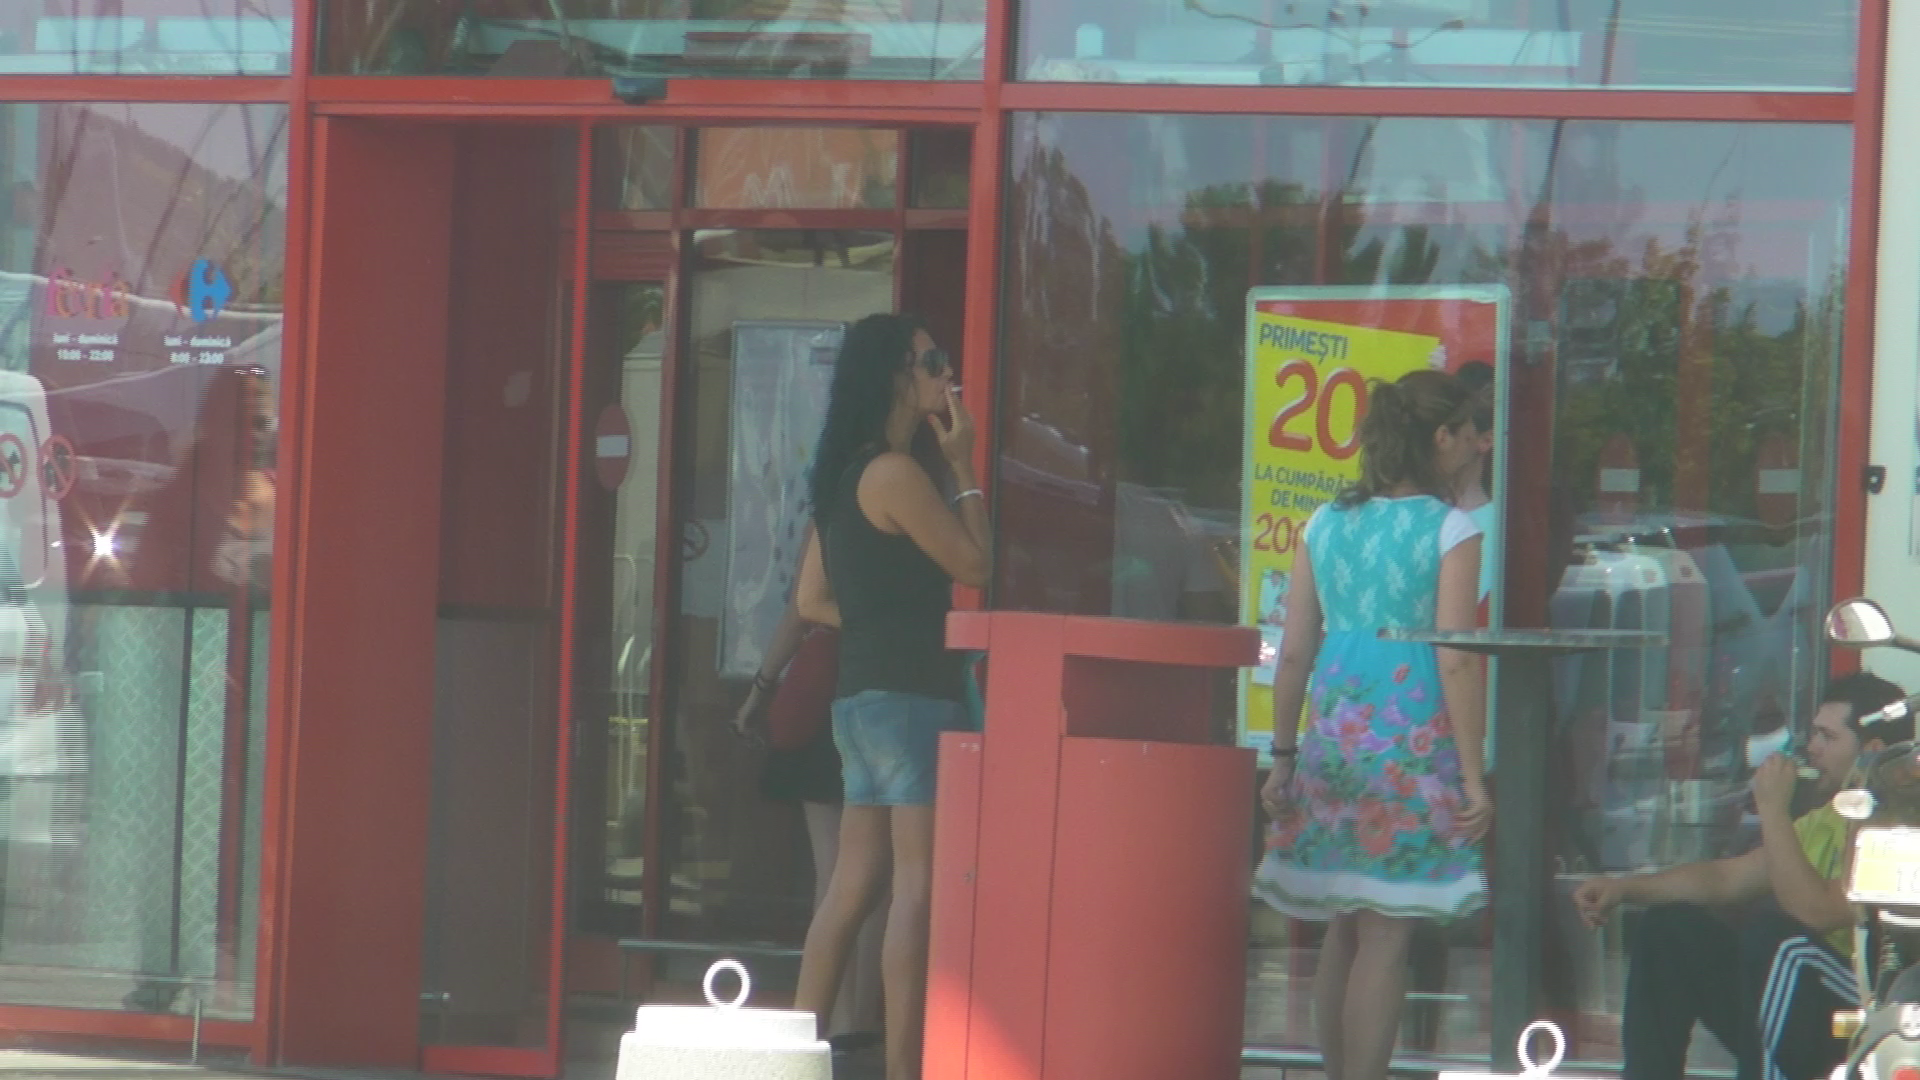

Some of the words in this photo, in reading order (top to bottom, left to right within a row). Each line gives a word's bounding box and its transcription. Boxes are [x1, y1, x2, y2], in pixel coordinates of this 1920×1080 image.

[1267, 359, 1368, 461] 20
[1254, 463, 1273, 481] LA
[1270, 488, 1291, 508] DE
